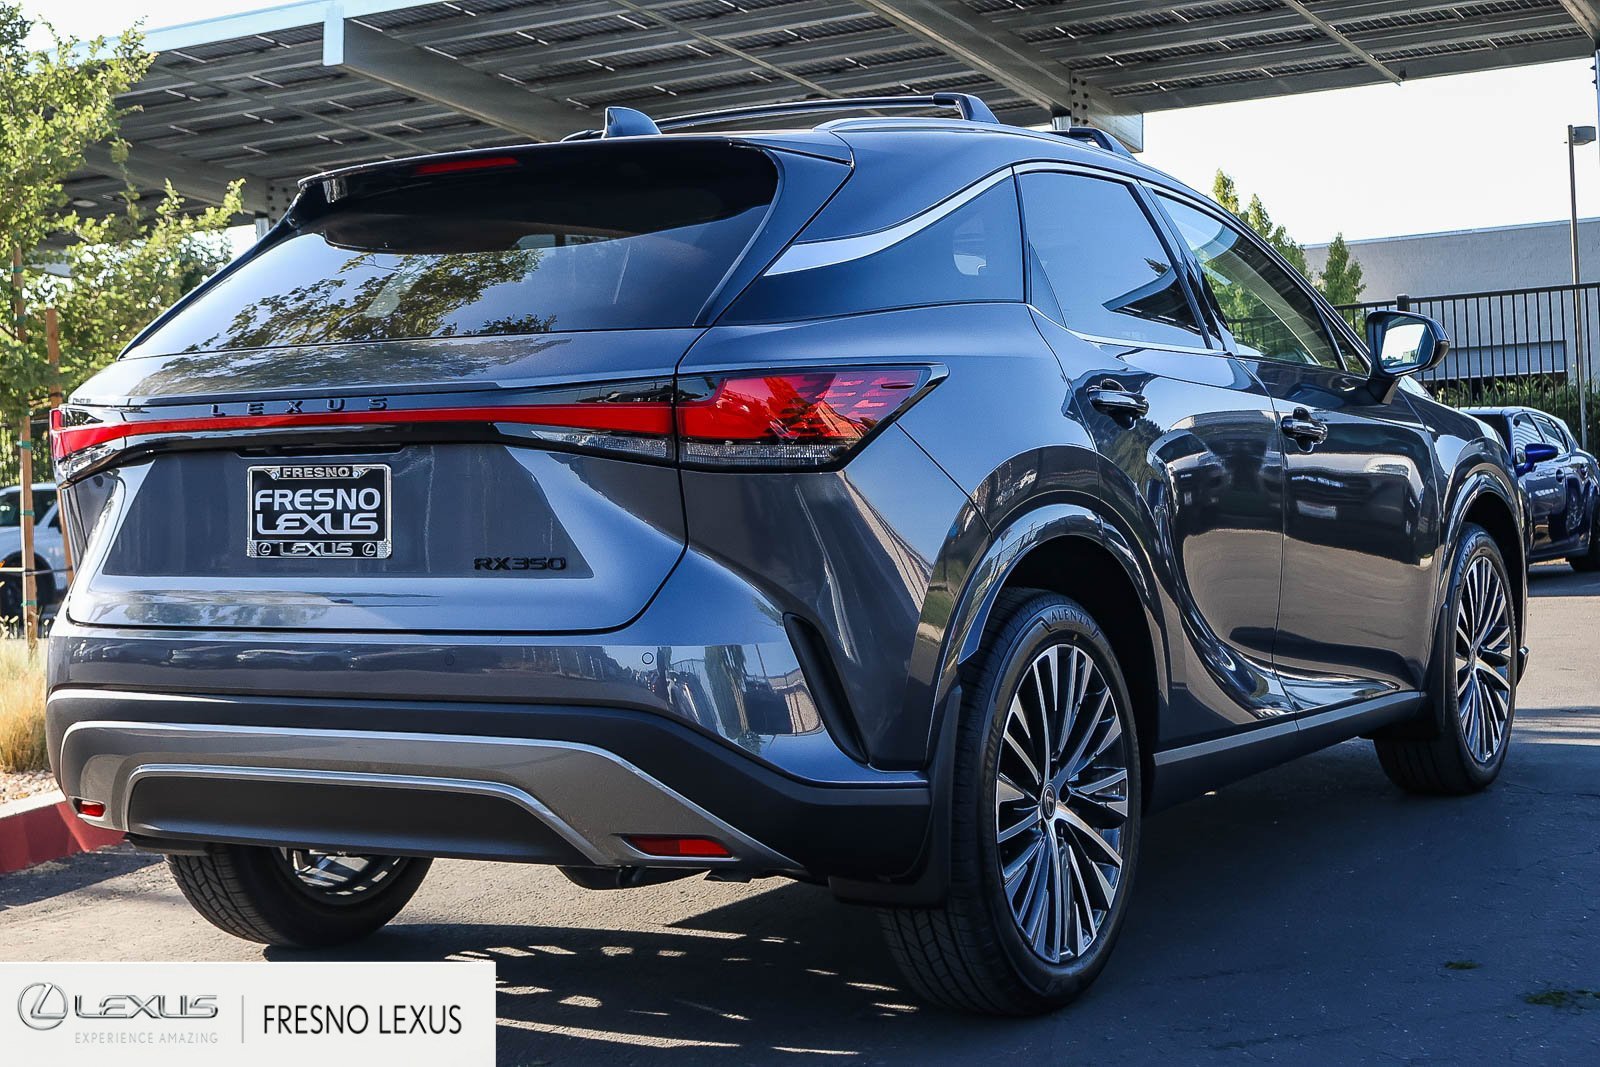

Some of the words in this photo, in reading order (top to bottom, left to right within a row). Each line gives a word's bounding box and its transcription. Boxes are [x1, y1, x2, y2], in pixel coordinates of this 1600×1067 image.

[210, 397, 388, 417] LEXUS
[282, 466, 350, 478] FRESNO
[254, 487, 381, 511] FRESNO
[256, 512, 379, 535] LEXUS
[279, 542, 354, 557] LEXUS
[473, 556, 567, 571] RX350
[1050, 608, 1093, 630] ALENZA
